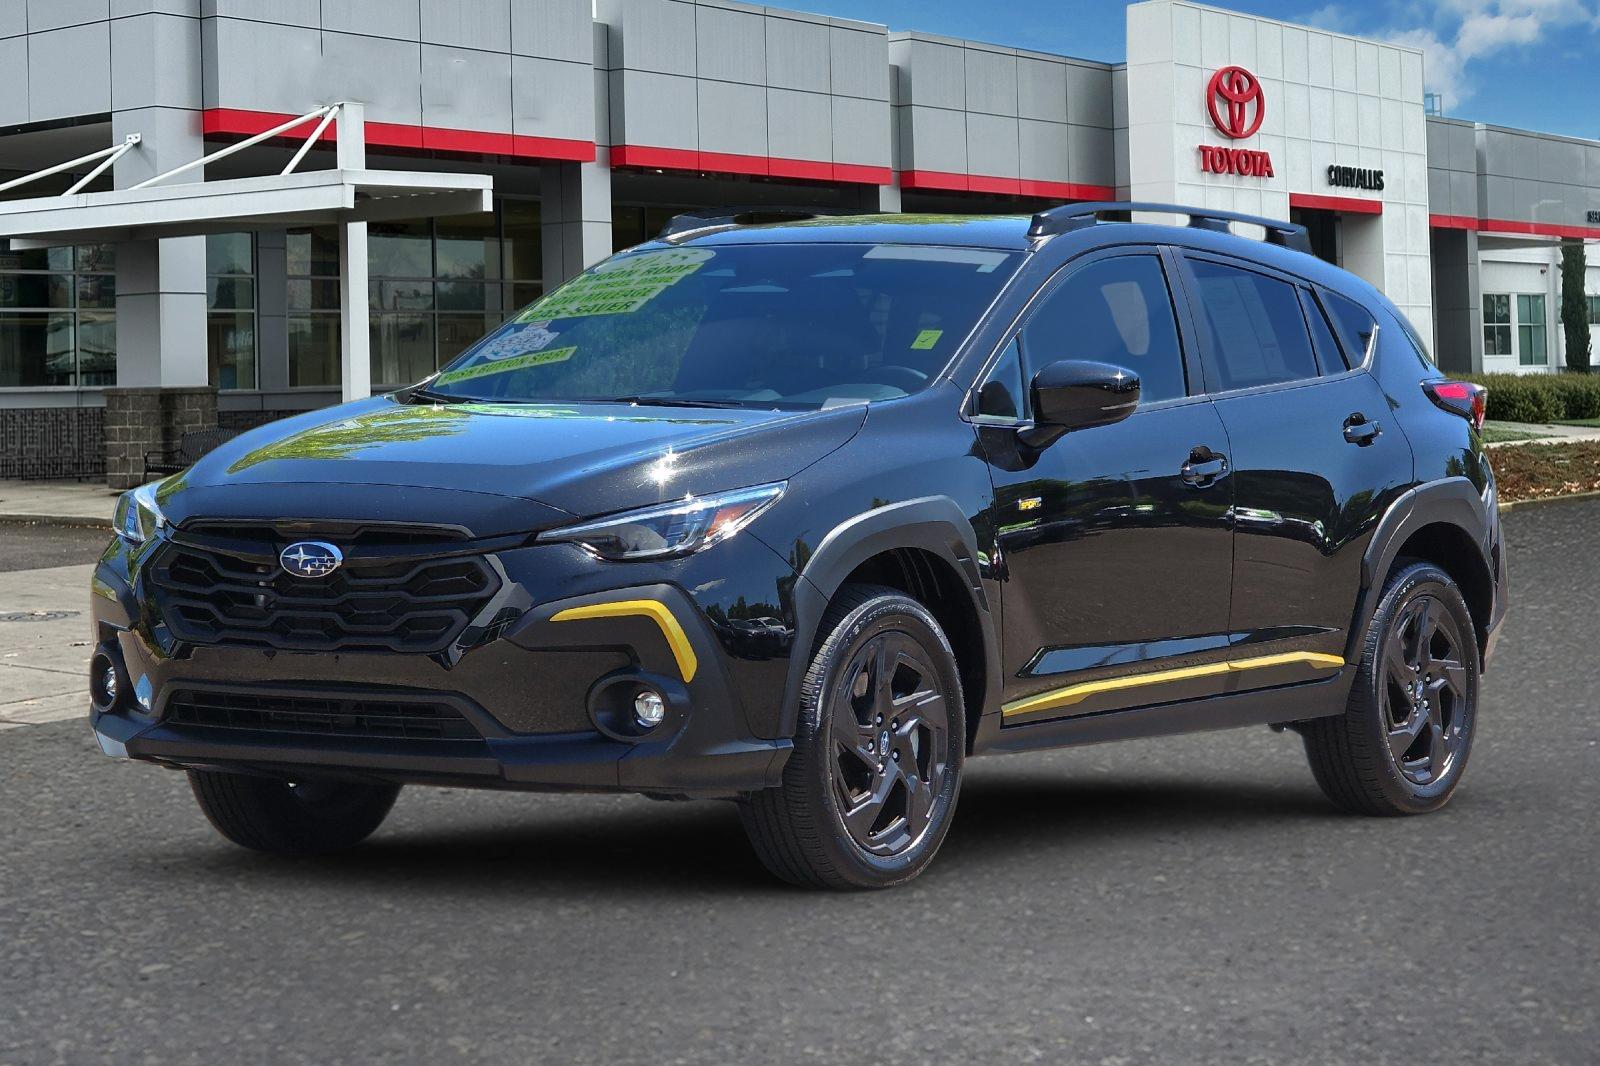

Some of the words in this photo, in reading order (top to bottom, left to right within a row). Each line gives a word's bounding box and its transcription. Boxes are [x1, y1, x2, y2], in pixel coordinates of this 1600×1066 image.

[1199, 145, 1274, 178] TOYOTA
[1327, 164, 1384, 191] CORVALLIS
[641, 262, 700, 276] ROOF
[568, 301, 638, 315] SAVER
[529, 348, 572, 362] START
